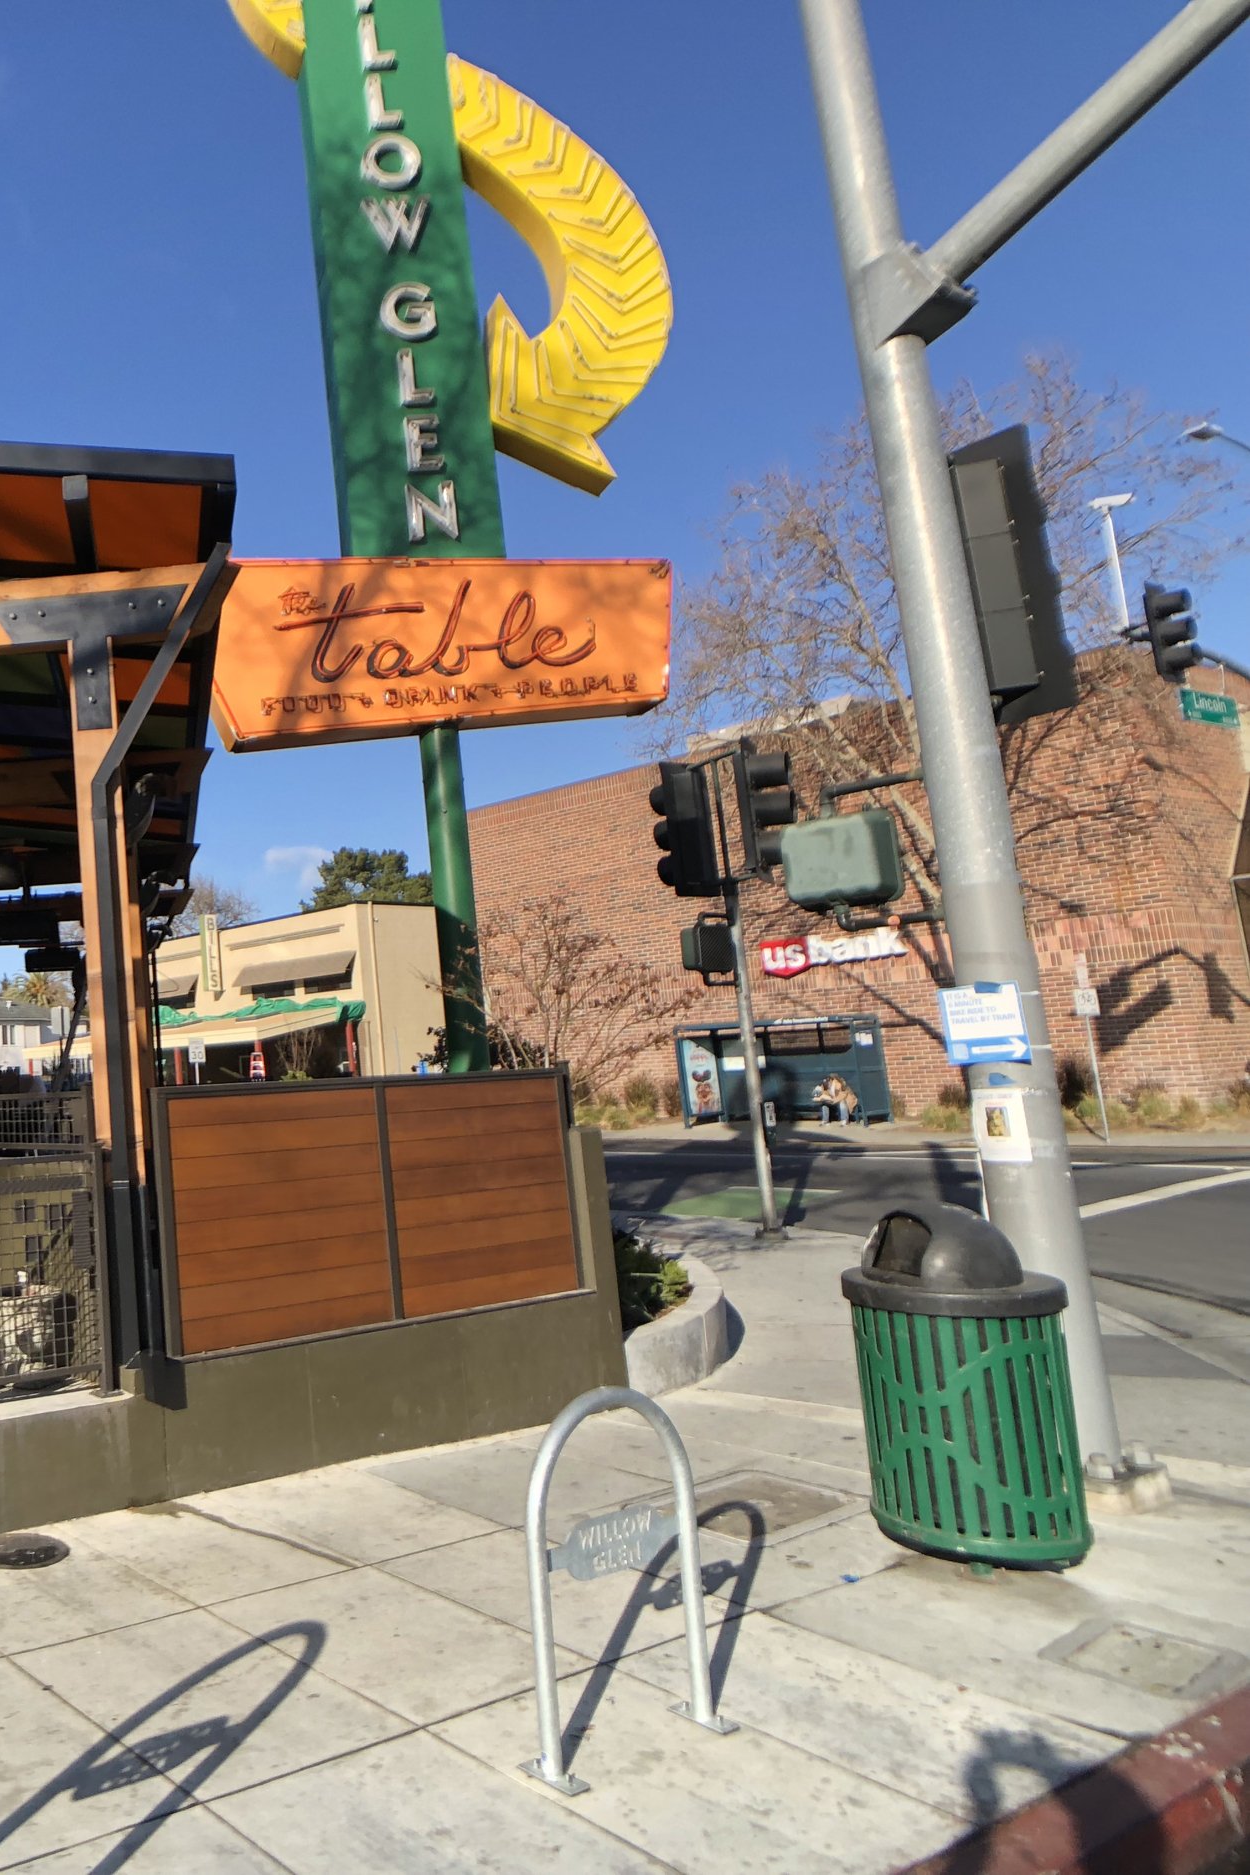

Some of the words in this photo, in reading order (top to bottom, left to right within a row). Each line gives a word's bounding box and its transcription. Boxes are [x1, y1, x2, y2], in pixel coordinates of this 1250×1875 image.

[356, 0, 431, 254] LLOW
[380, 281, 461, 543] GLEN
[273, 578, 597, 683] table
[1192, 691, 1228, 713] Lincoln
[206, 917, 219, 988] BILLS
[762, 944, 806, 970] us
[807, 926, 909, 965] bank
[951, 1016, 979, 1025] TRAVEL
[191, 1051, 204, 1060] 30
[579, 1509, 652, 1550] WILLOW
[592, 1541, 642, 1572] GLEN
